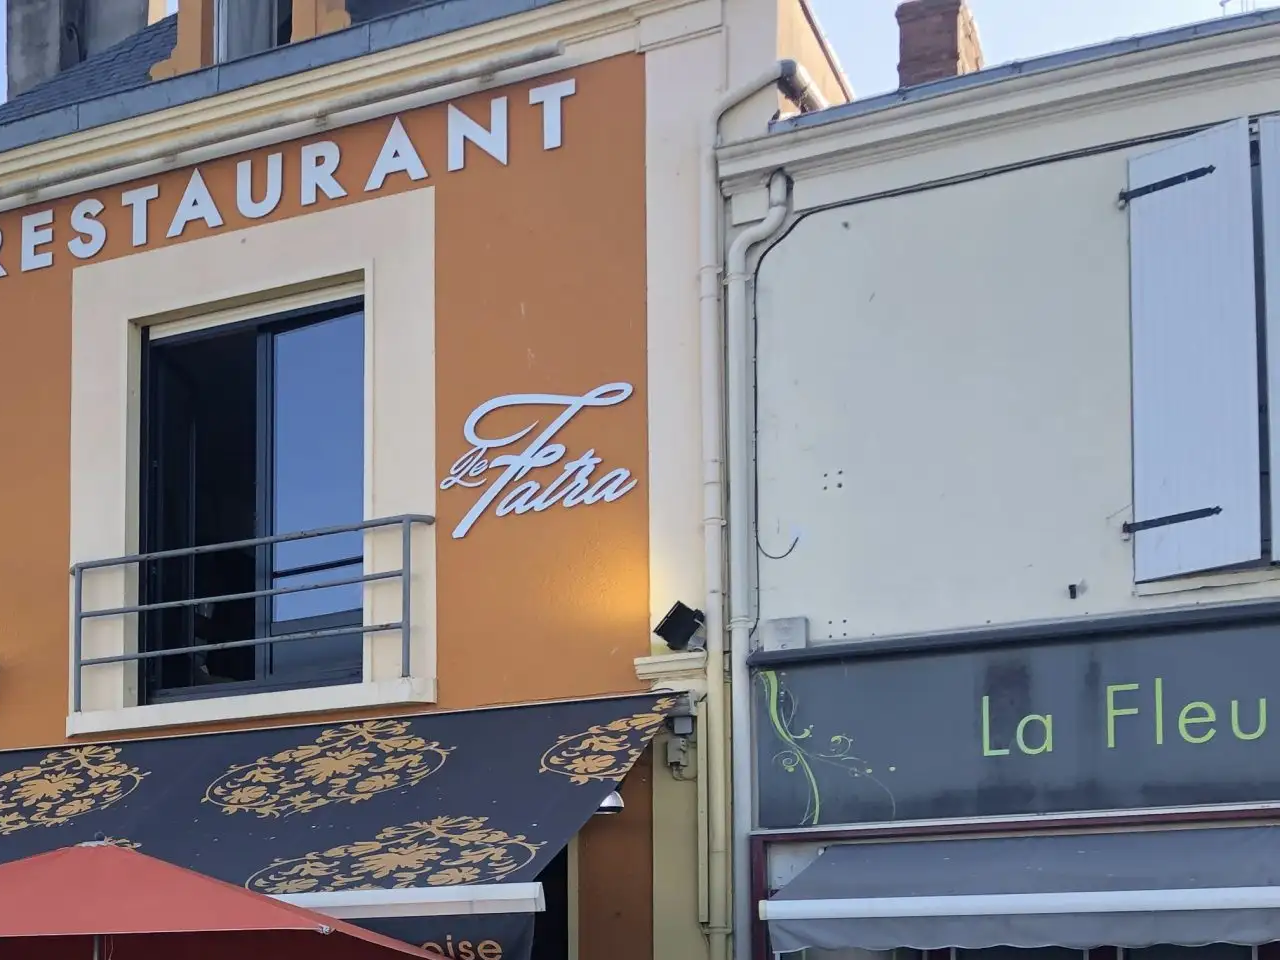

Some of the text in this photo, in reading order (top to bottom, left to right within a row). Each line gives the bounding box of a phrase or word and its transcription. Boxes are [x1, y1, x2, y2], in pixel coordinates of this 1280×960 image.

[439, 382, 638, 539] Le Fatra
[982, 677, 1267, 757] La Fleu
